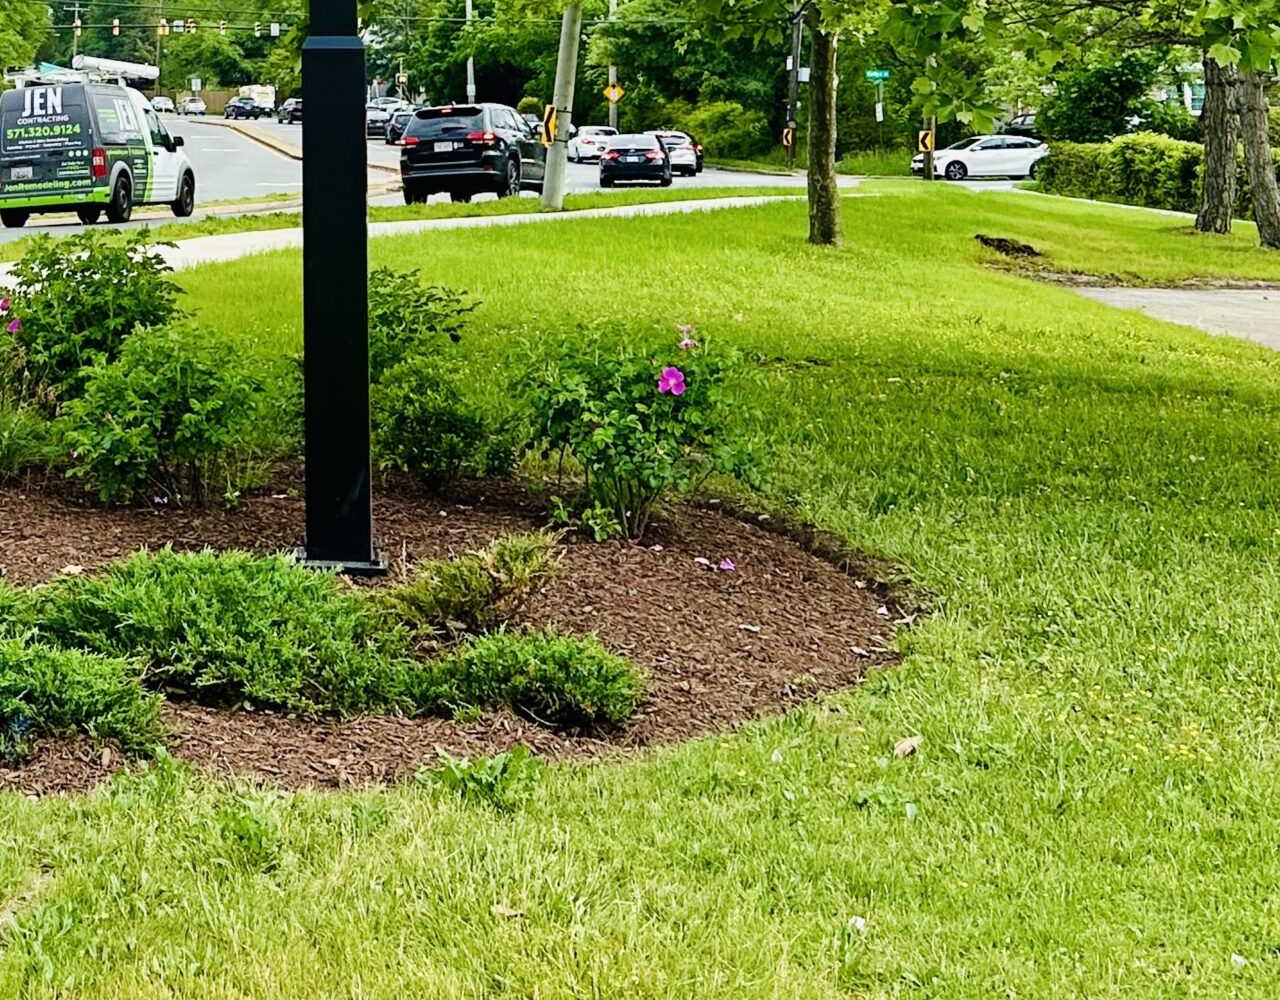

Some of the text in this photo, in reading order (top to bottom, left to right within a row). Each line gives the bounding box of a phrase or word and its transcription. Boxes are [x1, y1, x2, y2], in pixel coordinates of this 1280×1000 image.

[22, 87, 62, 117] JEN
[17, 115, 69, 125] CONTRACTING
[6, 124, 81, 139] 571.320.9124
[3, 180, 92, 192] JenRemodeling.com
